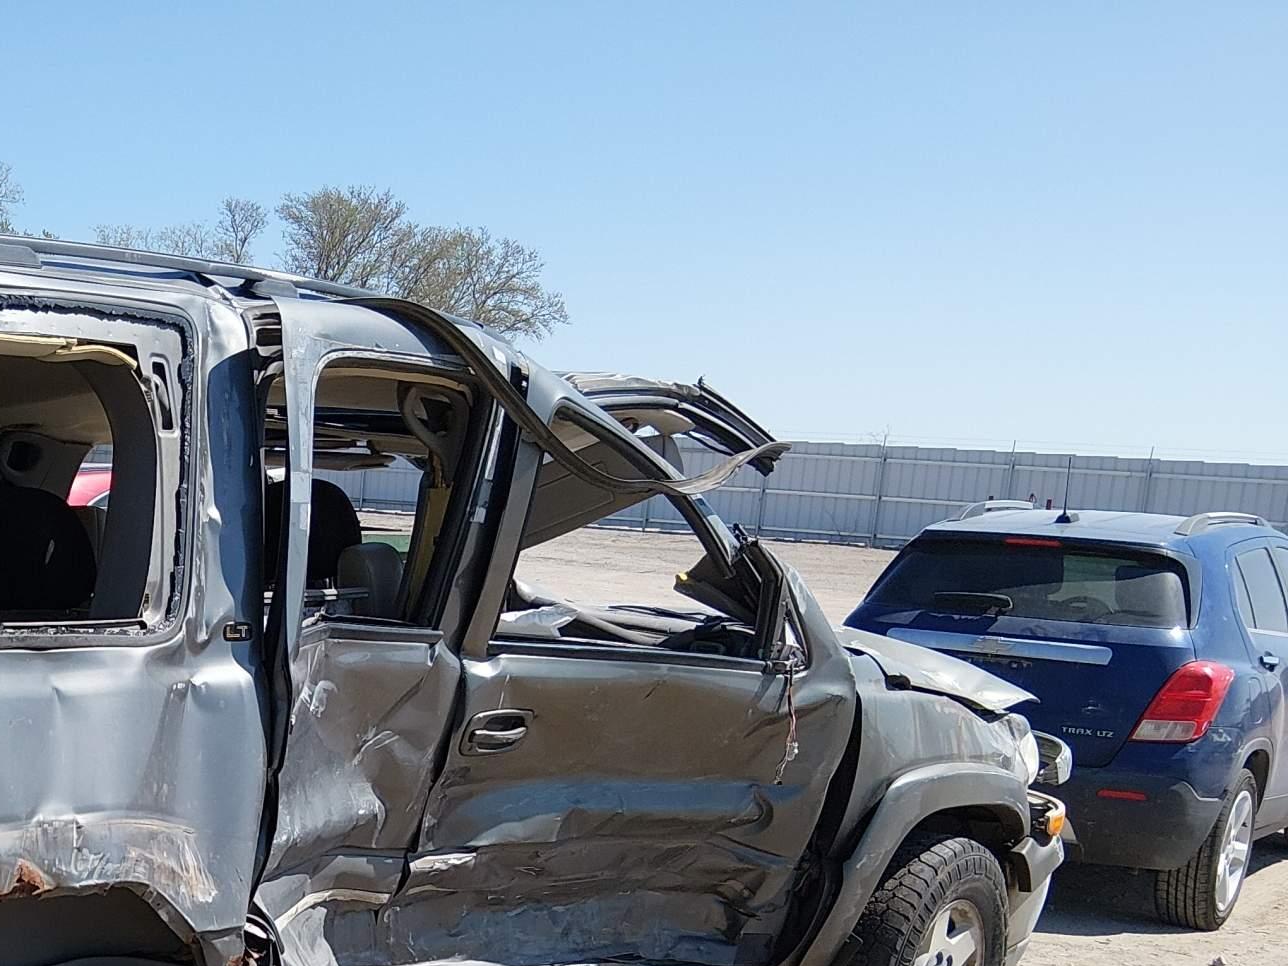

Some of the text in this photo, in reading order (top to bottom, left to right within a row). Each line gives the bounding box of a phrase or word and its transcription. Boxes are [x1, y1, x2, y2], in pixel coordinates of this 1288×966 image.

[226, 625, 249, 638] LT
[1061, 726, 1114, 738] TRAX LTZ
